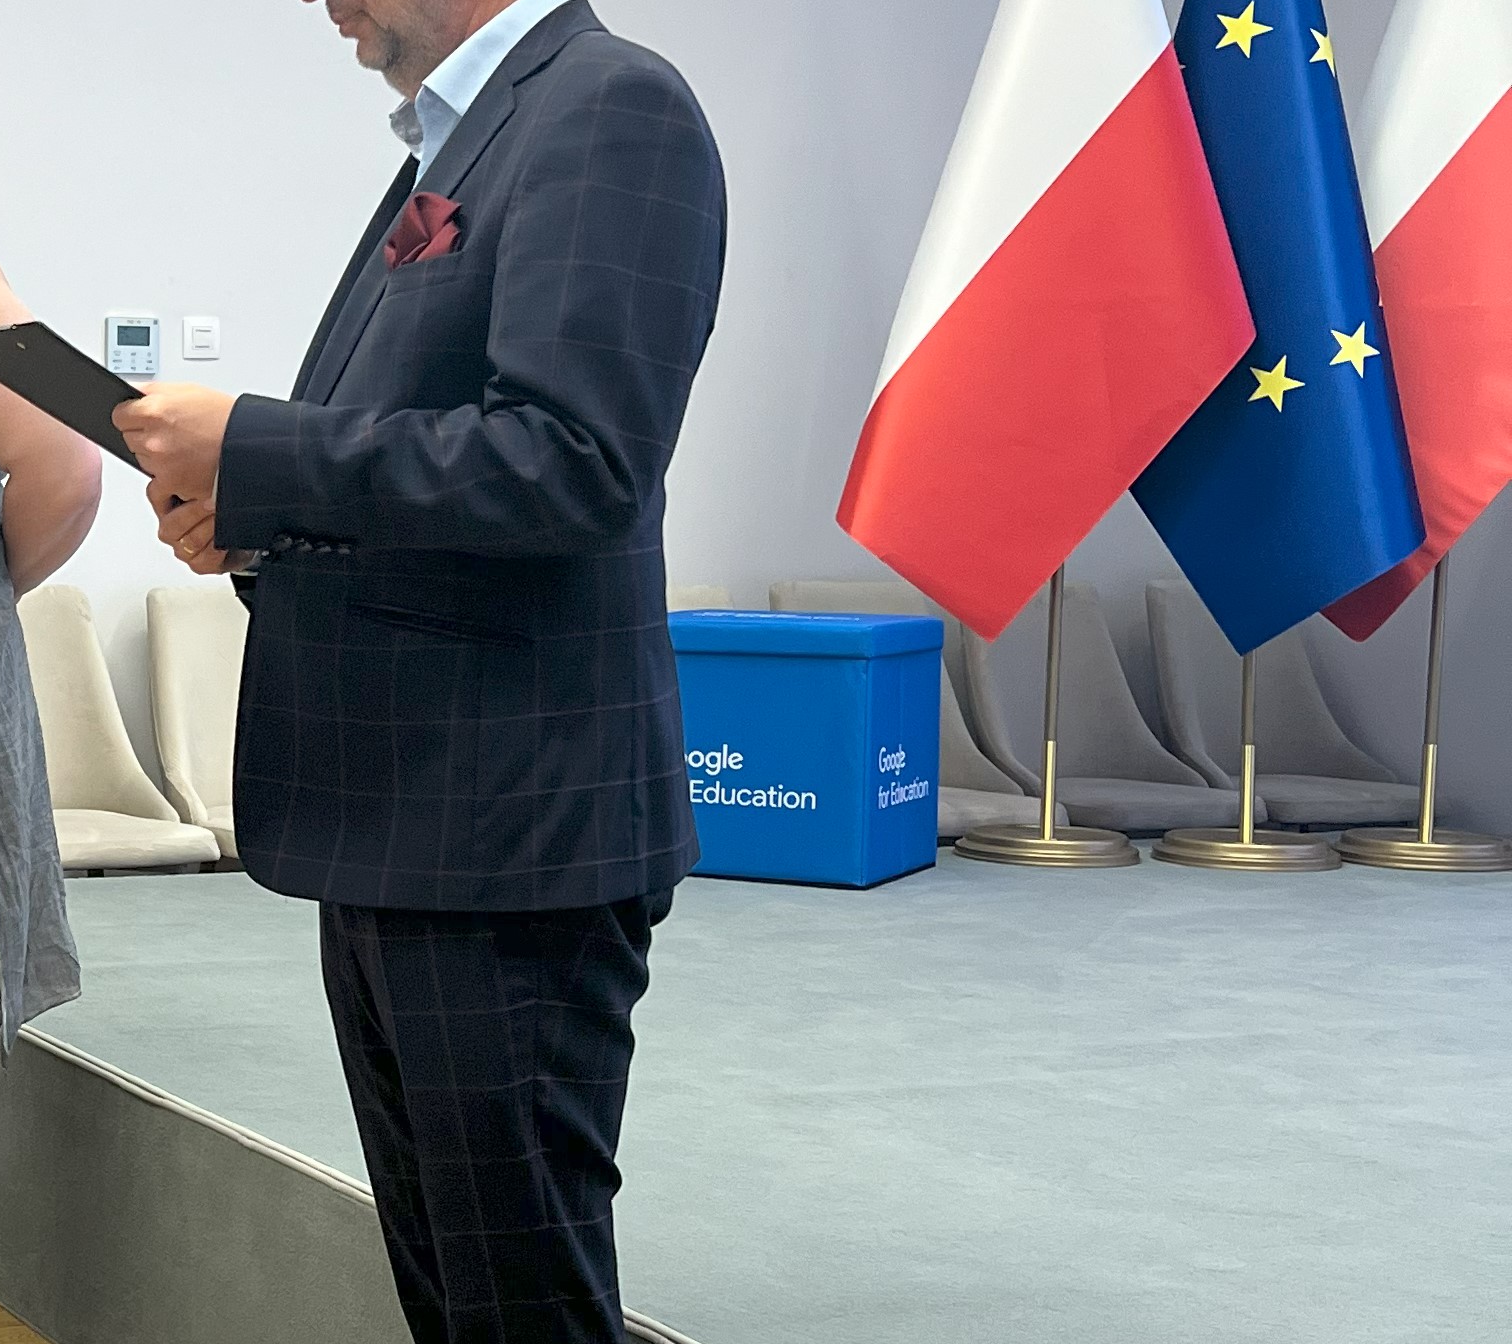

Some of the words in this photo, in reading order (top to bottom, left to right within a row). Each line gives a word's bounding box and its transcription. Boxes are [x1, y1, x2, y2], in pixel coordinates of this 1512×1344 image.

[684, 744, 744, 775] ogle
[878, 744, 906, 776] Google
[689, 779, 817, 810] Education
[878, 786, 890, 810] for
[890, 776, 929, 806] Education
